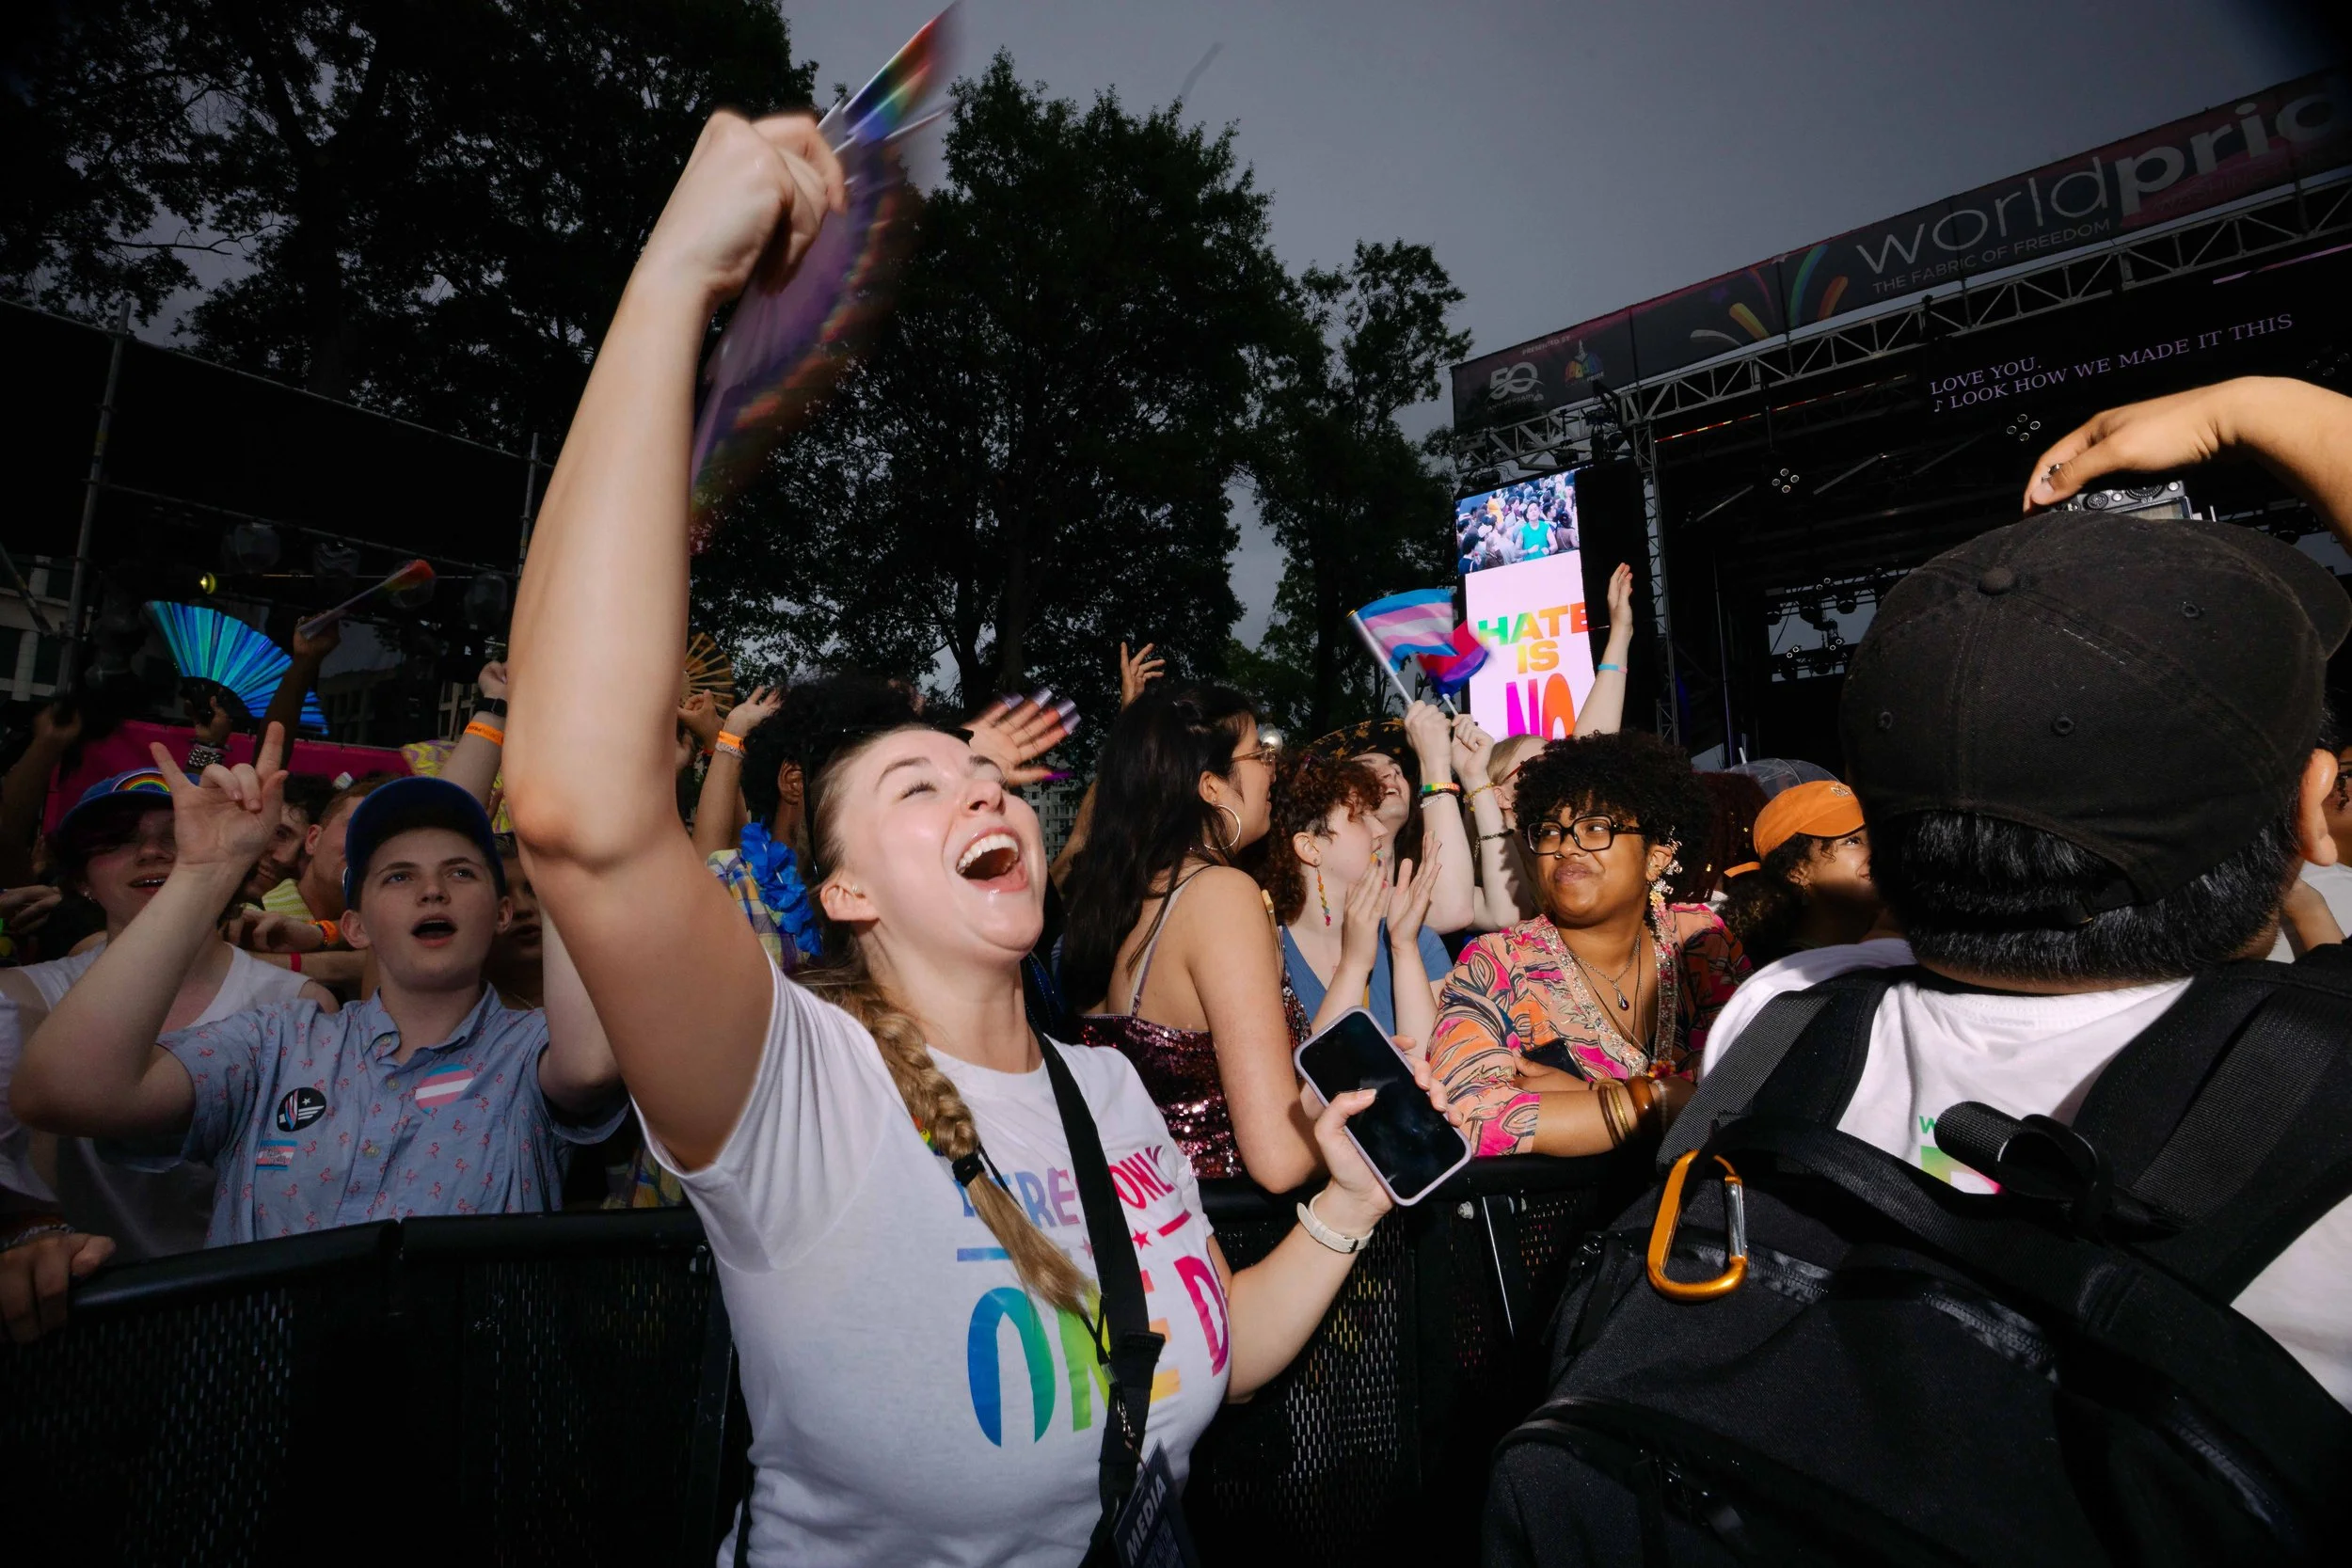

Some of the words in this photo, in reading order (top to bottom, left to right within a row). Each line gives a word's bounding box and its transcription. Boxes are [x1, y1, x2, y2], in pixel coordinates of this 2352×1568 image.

[1872, 274, 1908, 294] THE
[1911, 254, 1978, 285] FABRIC
[1981, 245, 2010, 264] OF
[2013, 217, 2112, 256] FREEDOM
[1490, 361, 1540, 400] 50
[1929, 371, 1985, 396] LOVE
[1989, 356, 2042, 381] YOU.
[1949, 384, 2009, 409] LOOK
[2014, 369, 2069, 395] HOW
[2074, 357, 2112, 378] WE
[2118, 338, 2191, 369] MADE
[2198, 330, 2223, 349] IT
[2228, 312, 2294, 343] THIS
[1477, 602, 1589, 646] HATE
[1517, 640, 1559, 674] IS
[1126, 1473, 1167, 1567] MEDIA
